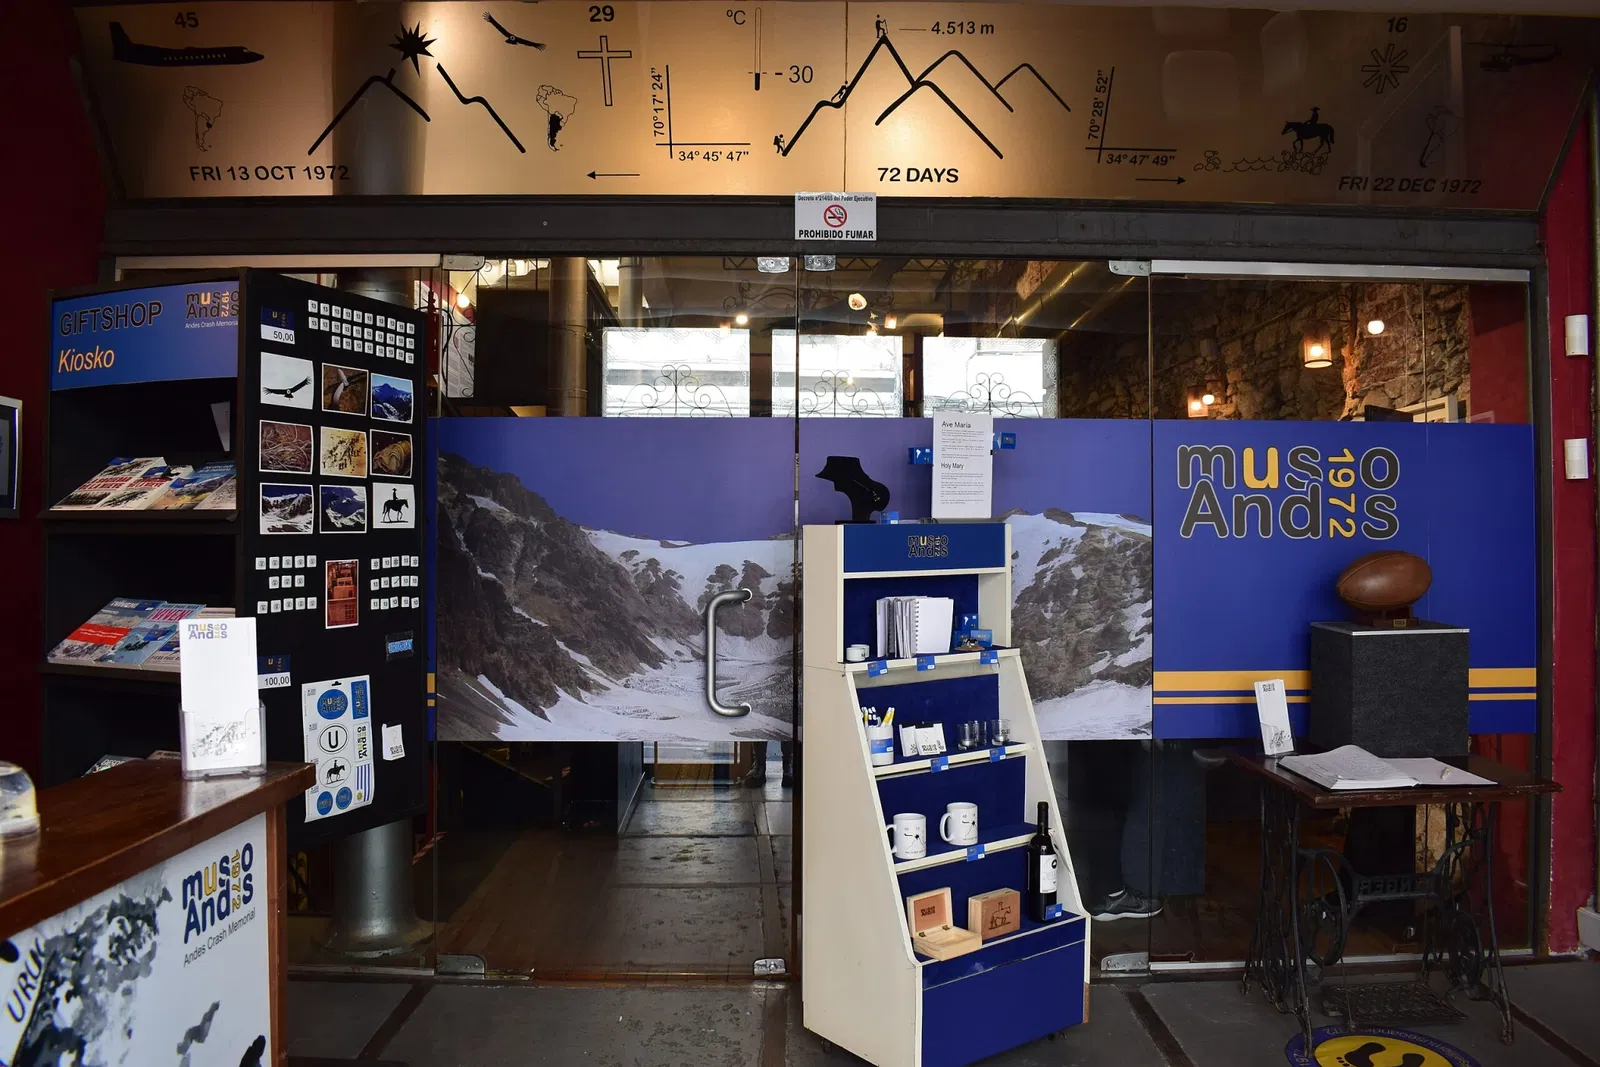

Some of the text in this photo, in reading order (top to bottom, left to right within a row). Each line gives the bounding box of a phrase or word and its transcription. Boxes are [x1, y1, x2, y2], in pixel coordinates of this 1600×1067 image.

[174, 11, 200, 29] 45
[588, 5, 615, 22] 29
[931, 21, 995, 36] 4.513 m
[1386, 16, 1408, 33] 16
[190, 166, 350, 182] FRI 13 OCT 1972
[877, 168, 960, 184] 72 DAYS
[1338, 176, 1482, 194] FRI 22 DEC 1972
[798, 230, 874, 239] PROHIBIDO FUMAR
[59, 301, 163, 336] GIFTSHOP
[274, 330, 294, 342] 50,00
[58, 346, 116, 374] Kiosko
[1328, 448, 1356, 539] 1972
[264, 676, 290, 686] 100,00
[328, 730, 339, 749] U
[183, 906, 256, 968] Andes Crash Memorial
